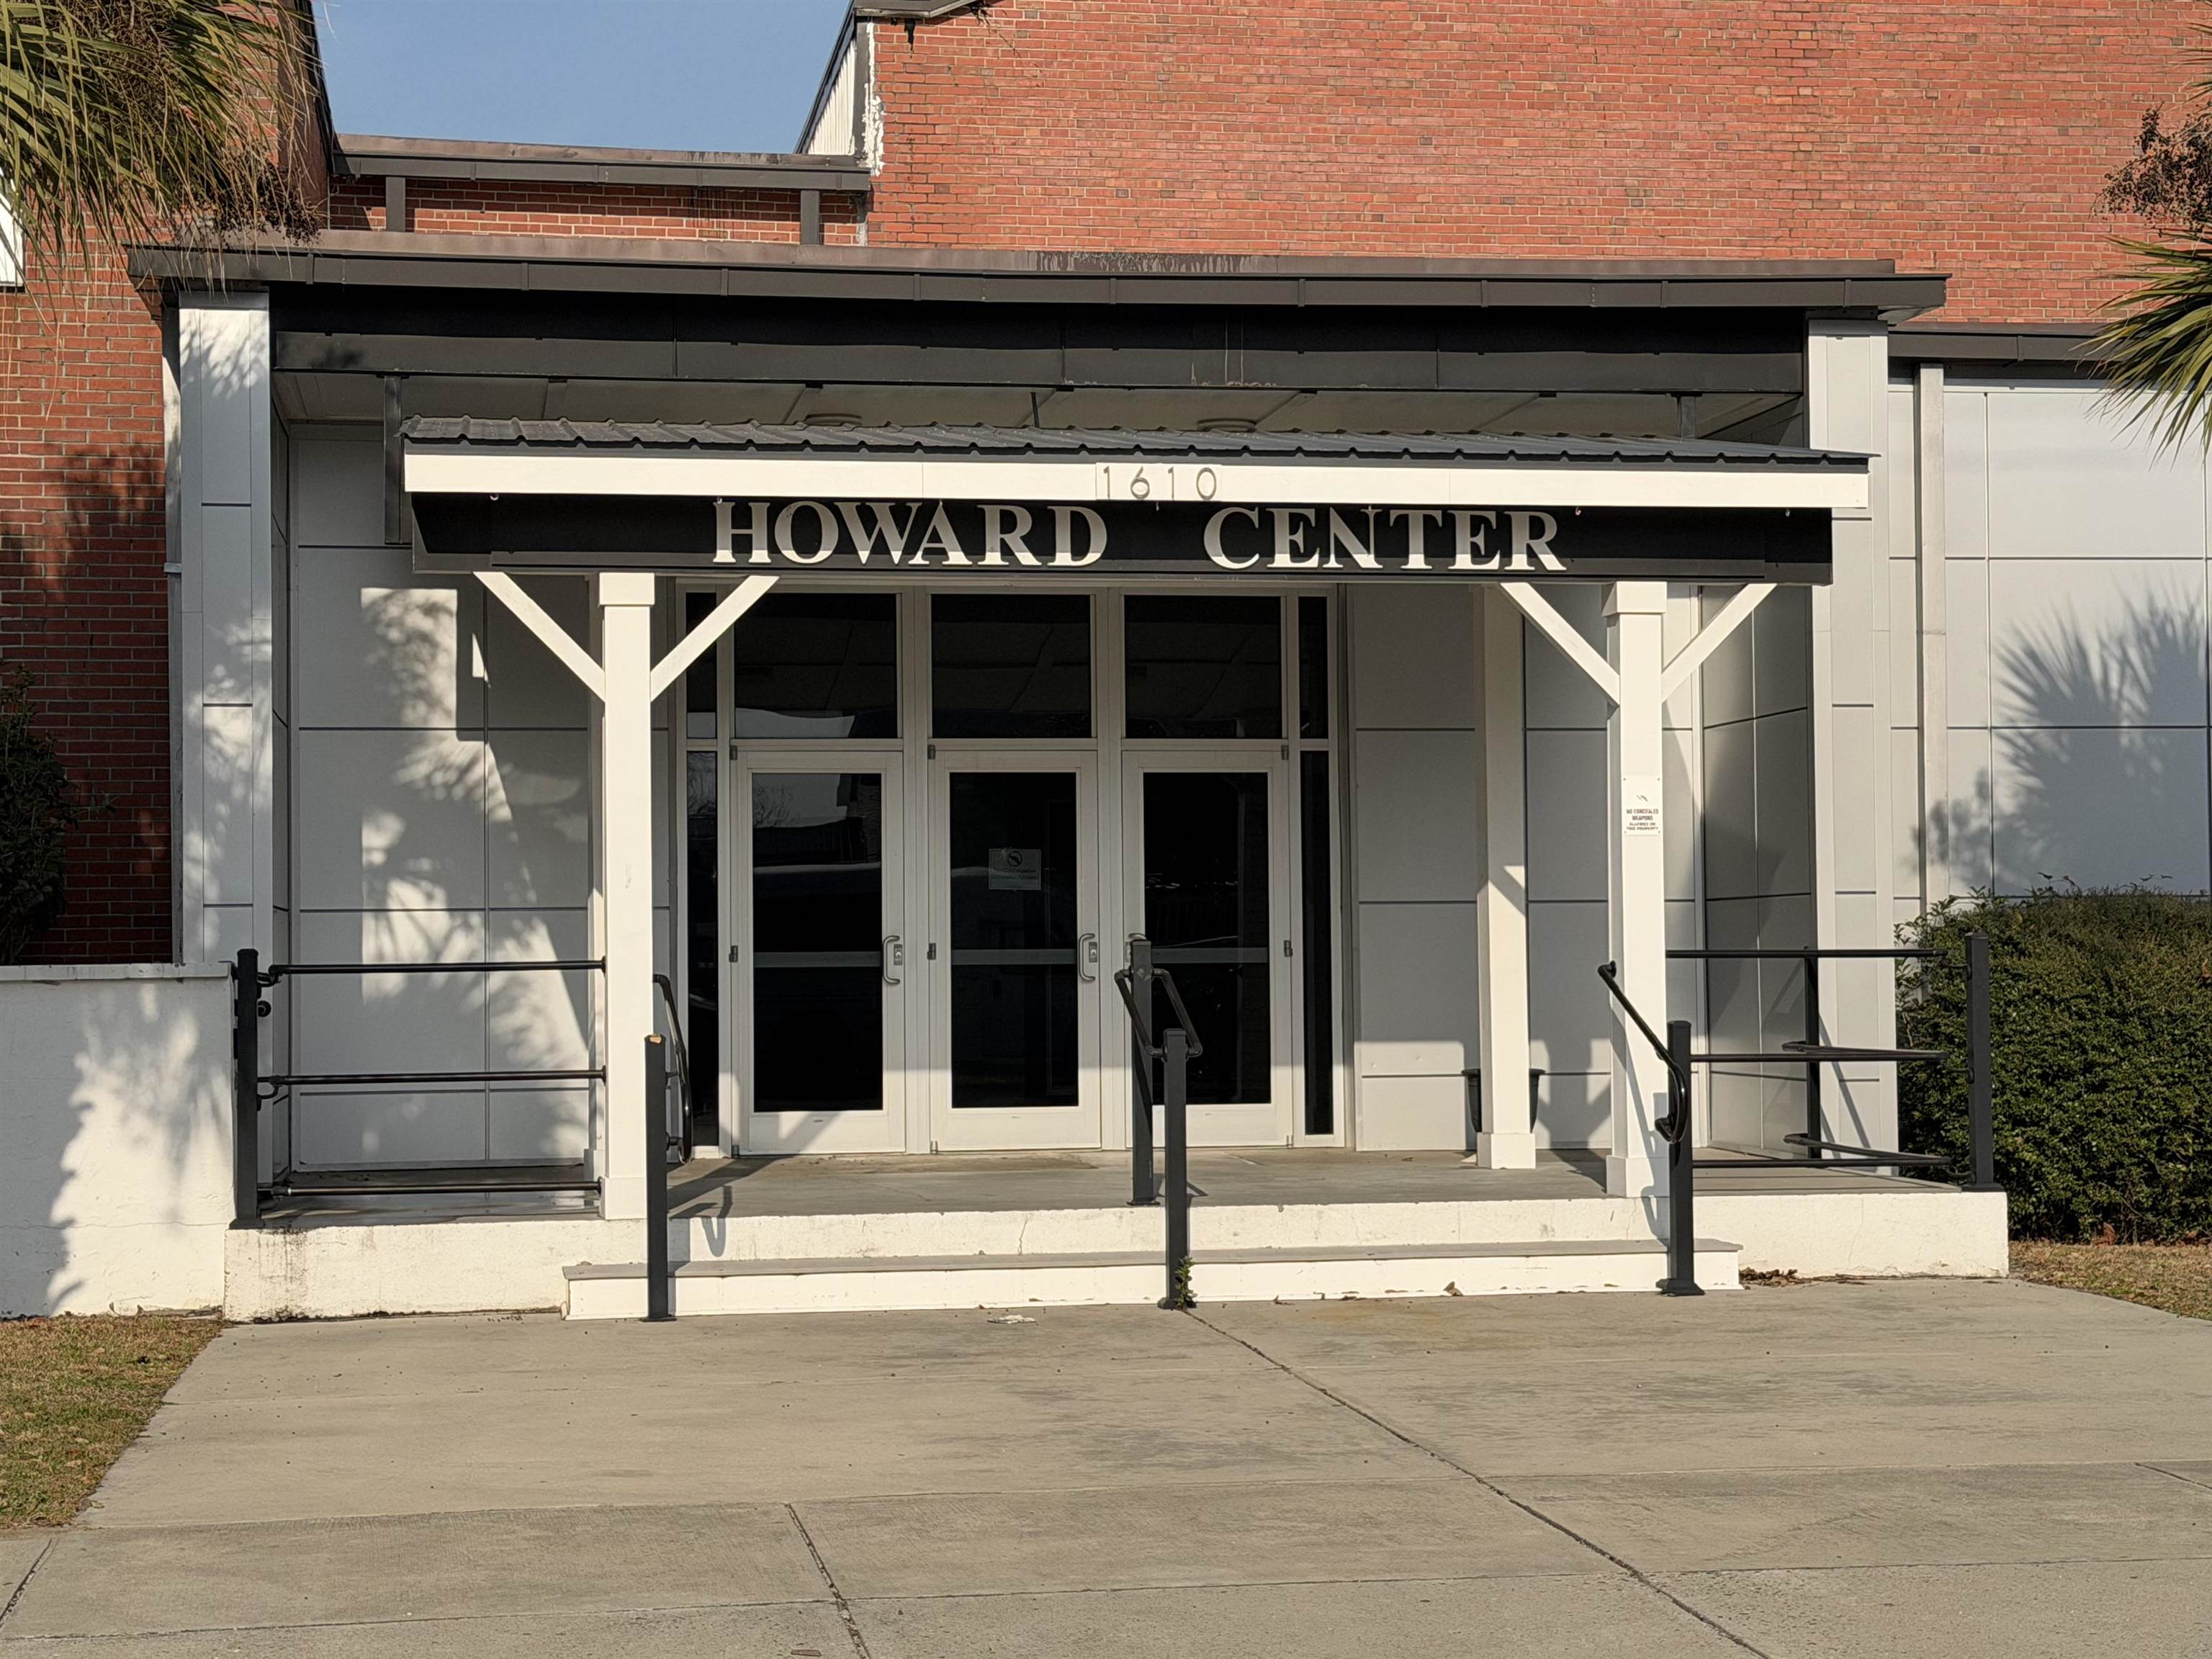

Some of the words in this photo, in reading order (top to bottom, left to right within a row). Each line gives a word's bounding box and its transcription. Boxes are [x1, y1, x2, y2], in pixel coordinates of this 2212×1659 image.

[1102, 465, 1218, 500] 1610
[712, 501, 1108, 567] HOWARD
[1203, 506, 1567, 571] CENTER
